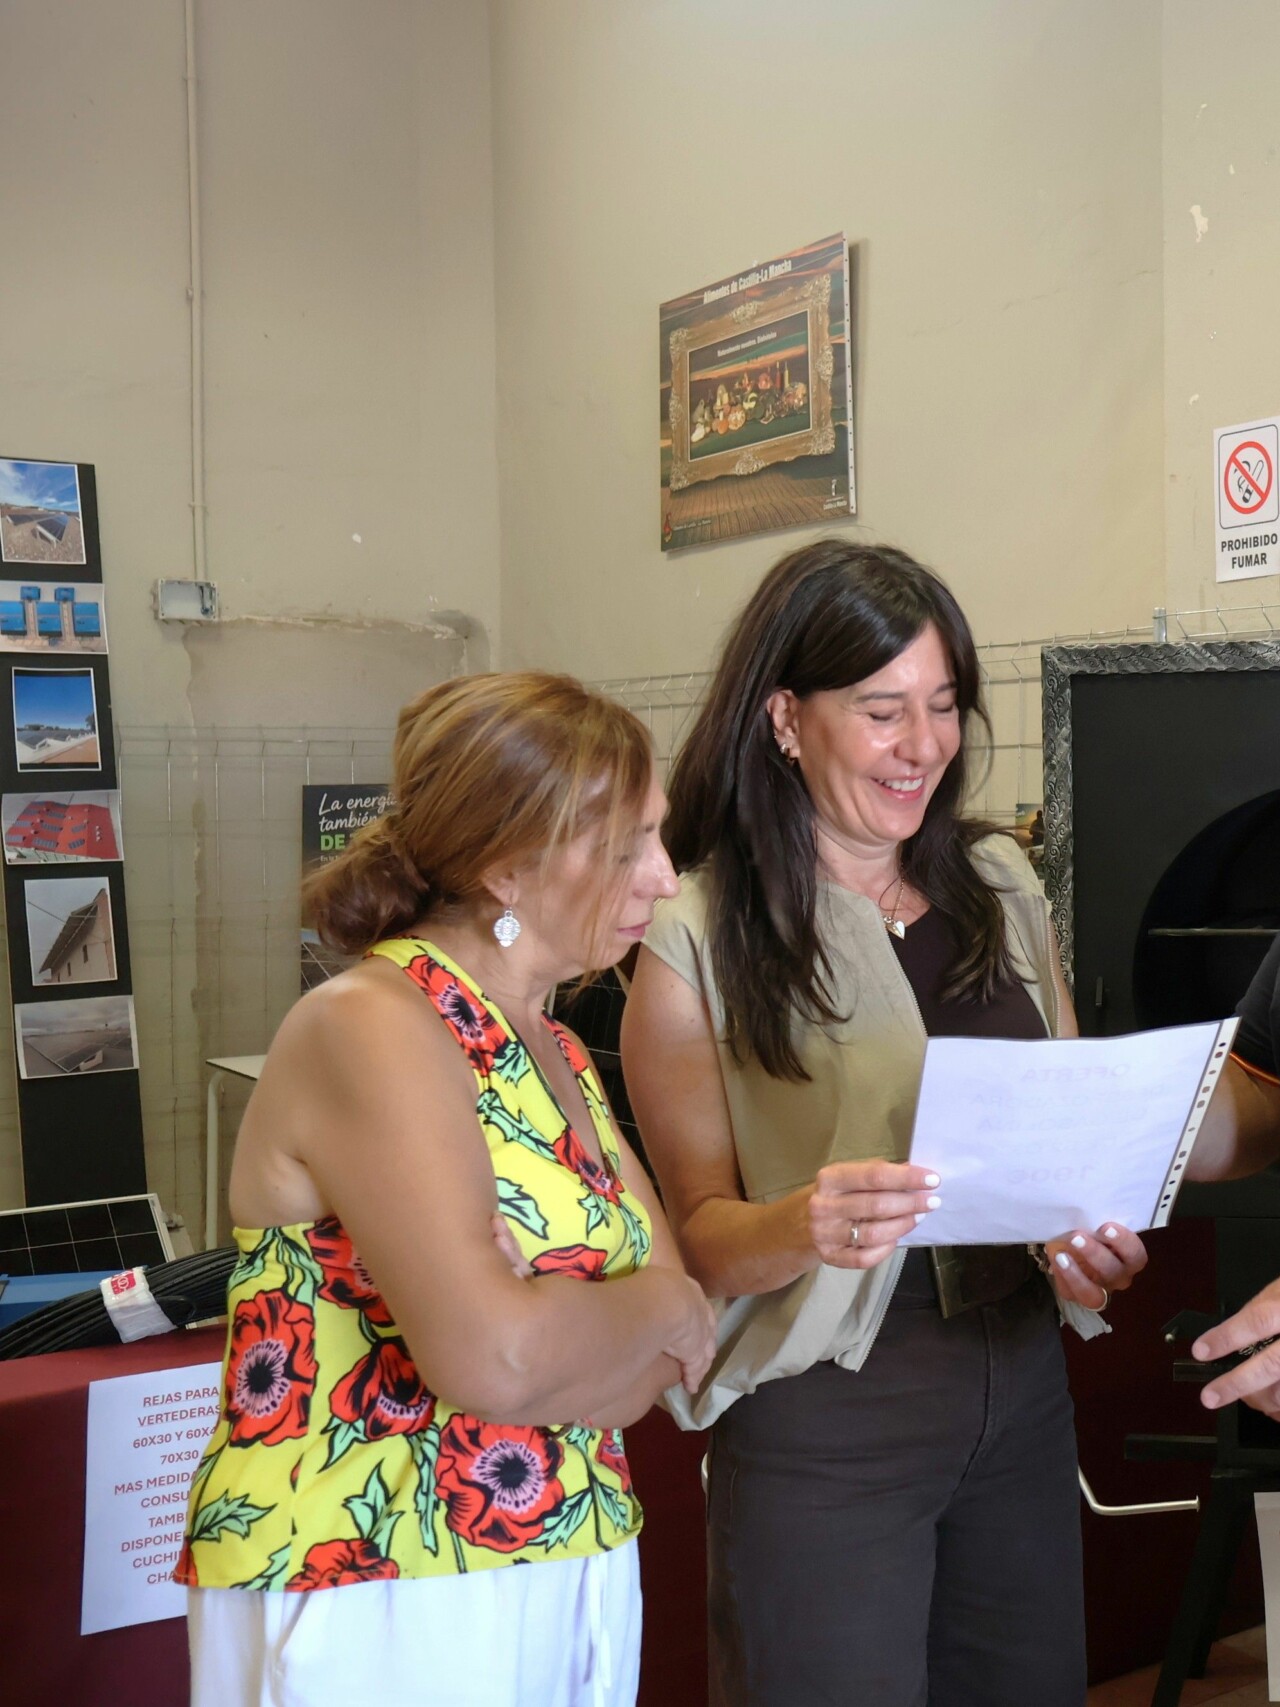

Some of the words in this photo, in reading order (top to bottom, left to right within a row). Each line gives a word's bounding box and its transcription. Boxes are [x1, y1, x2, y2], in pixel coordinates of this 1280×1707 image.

[769, 259, 792, 280] Mancha
[1221, 533, 1278, 553] PROHIBIDO
[1231, 552, 1268, 570] FUMAR
[318, 792, 344, 816] La
[318, 811, 378, 833] también
[320, 834, 345, 851] DE
[143, 1391, 182, 1408] REJAS
[185, 1386, 220, 1400] PARA
[137, 1404, 221, 1428] VERTEDERAS
[133, 1433, 172, 1449] 60X30
[175, 1431, 183, 1441] Y
[160, 1449, 199, 1465] 70X30
[114, 1480, 143, 1495] MAS
